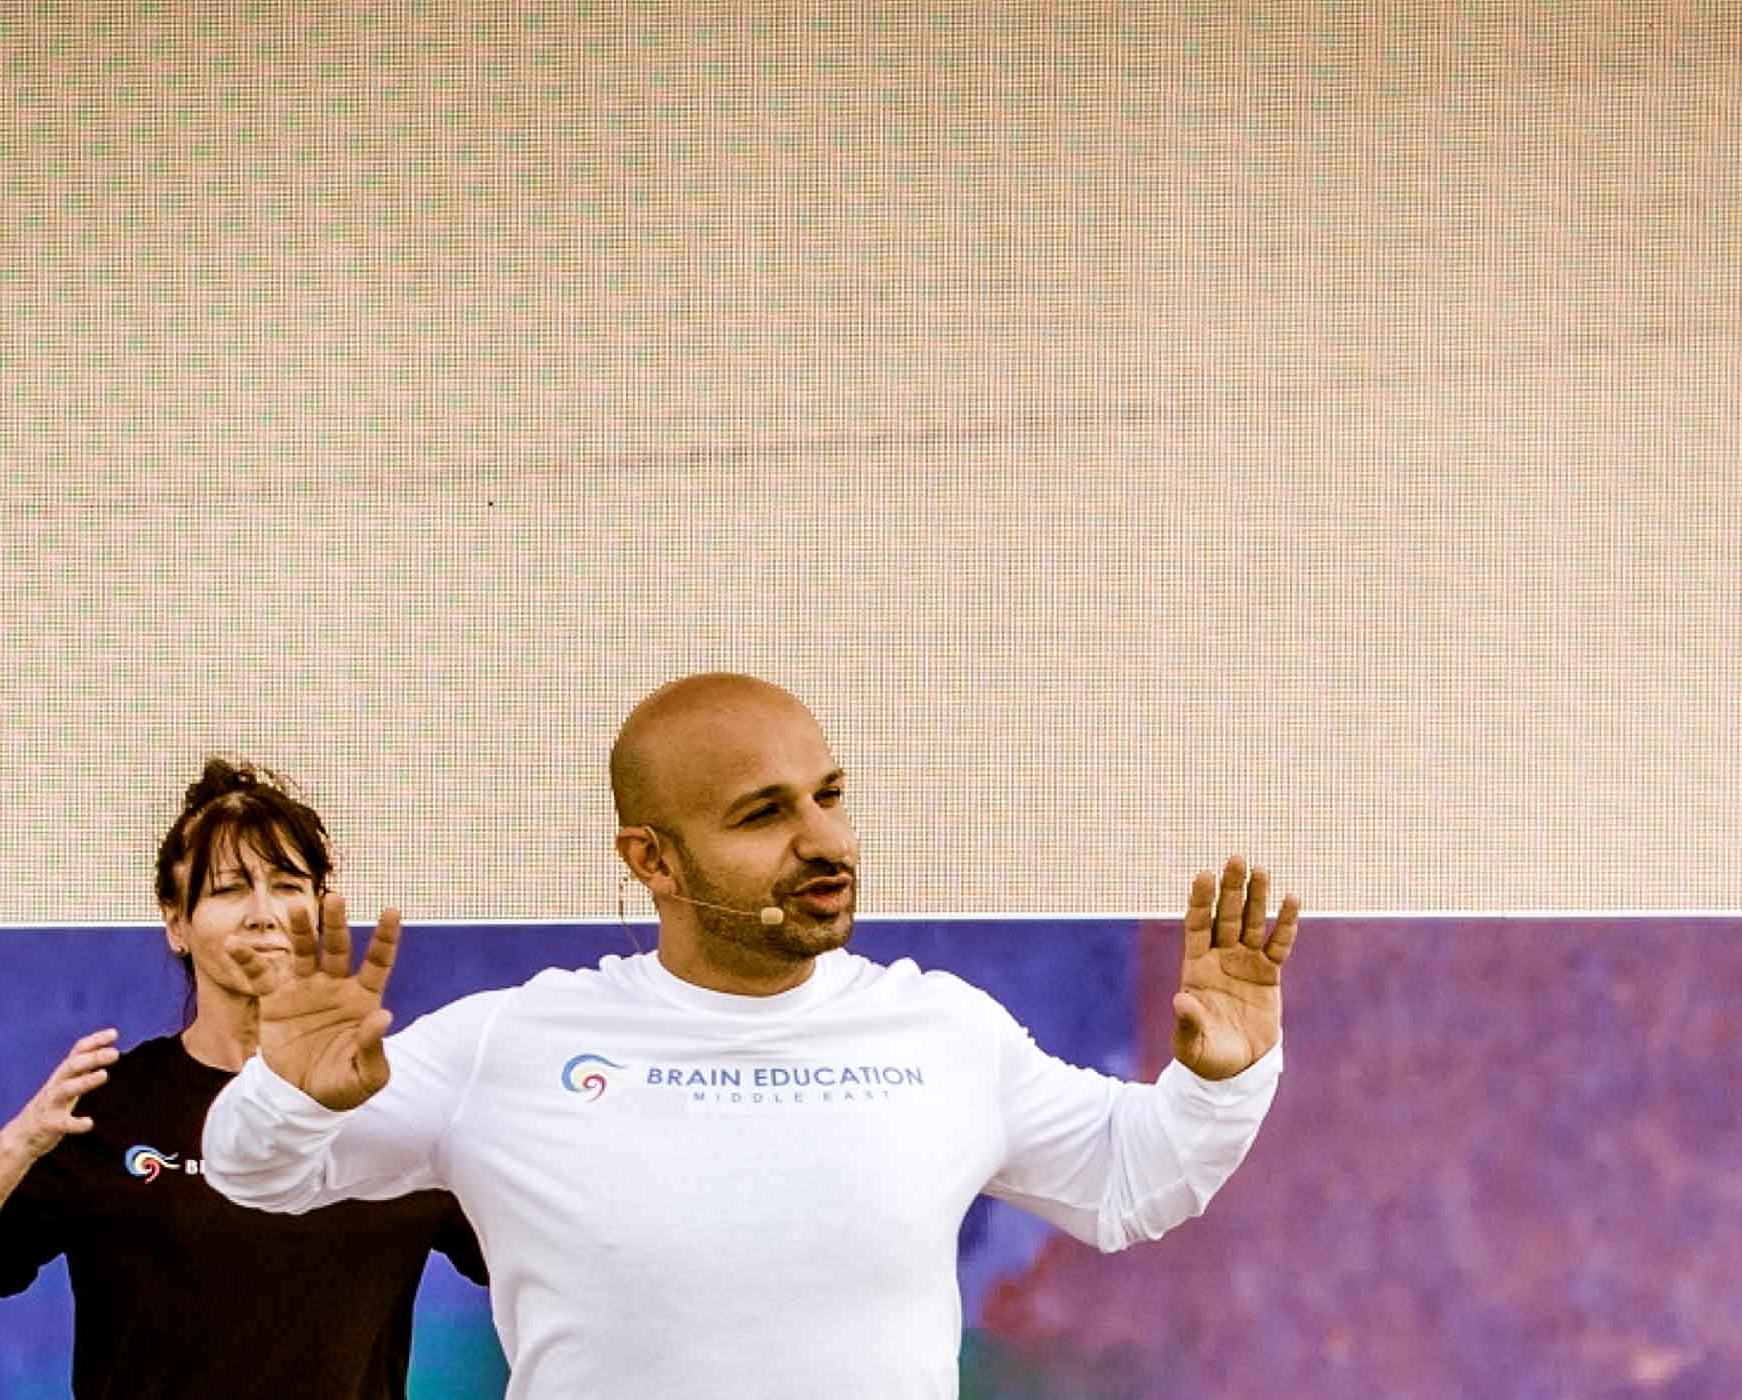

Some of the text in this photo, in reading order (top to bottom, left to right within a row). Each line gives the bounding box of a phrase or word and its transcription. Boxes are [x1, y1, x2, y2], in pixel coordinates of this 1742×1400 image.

[646, 1066, 925, 1087] BRAIN EDUCATION
[693, 1090, 804, 1104] MIDDLE
